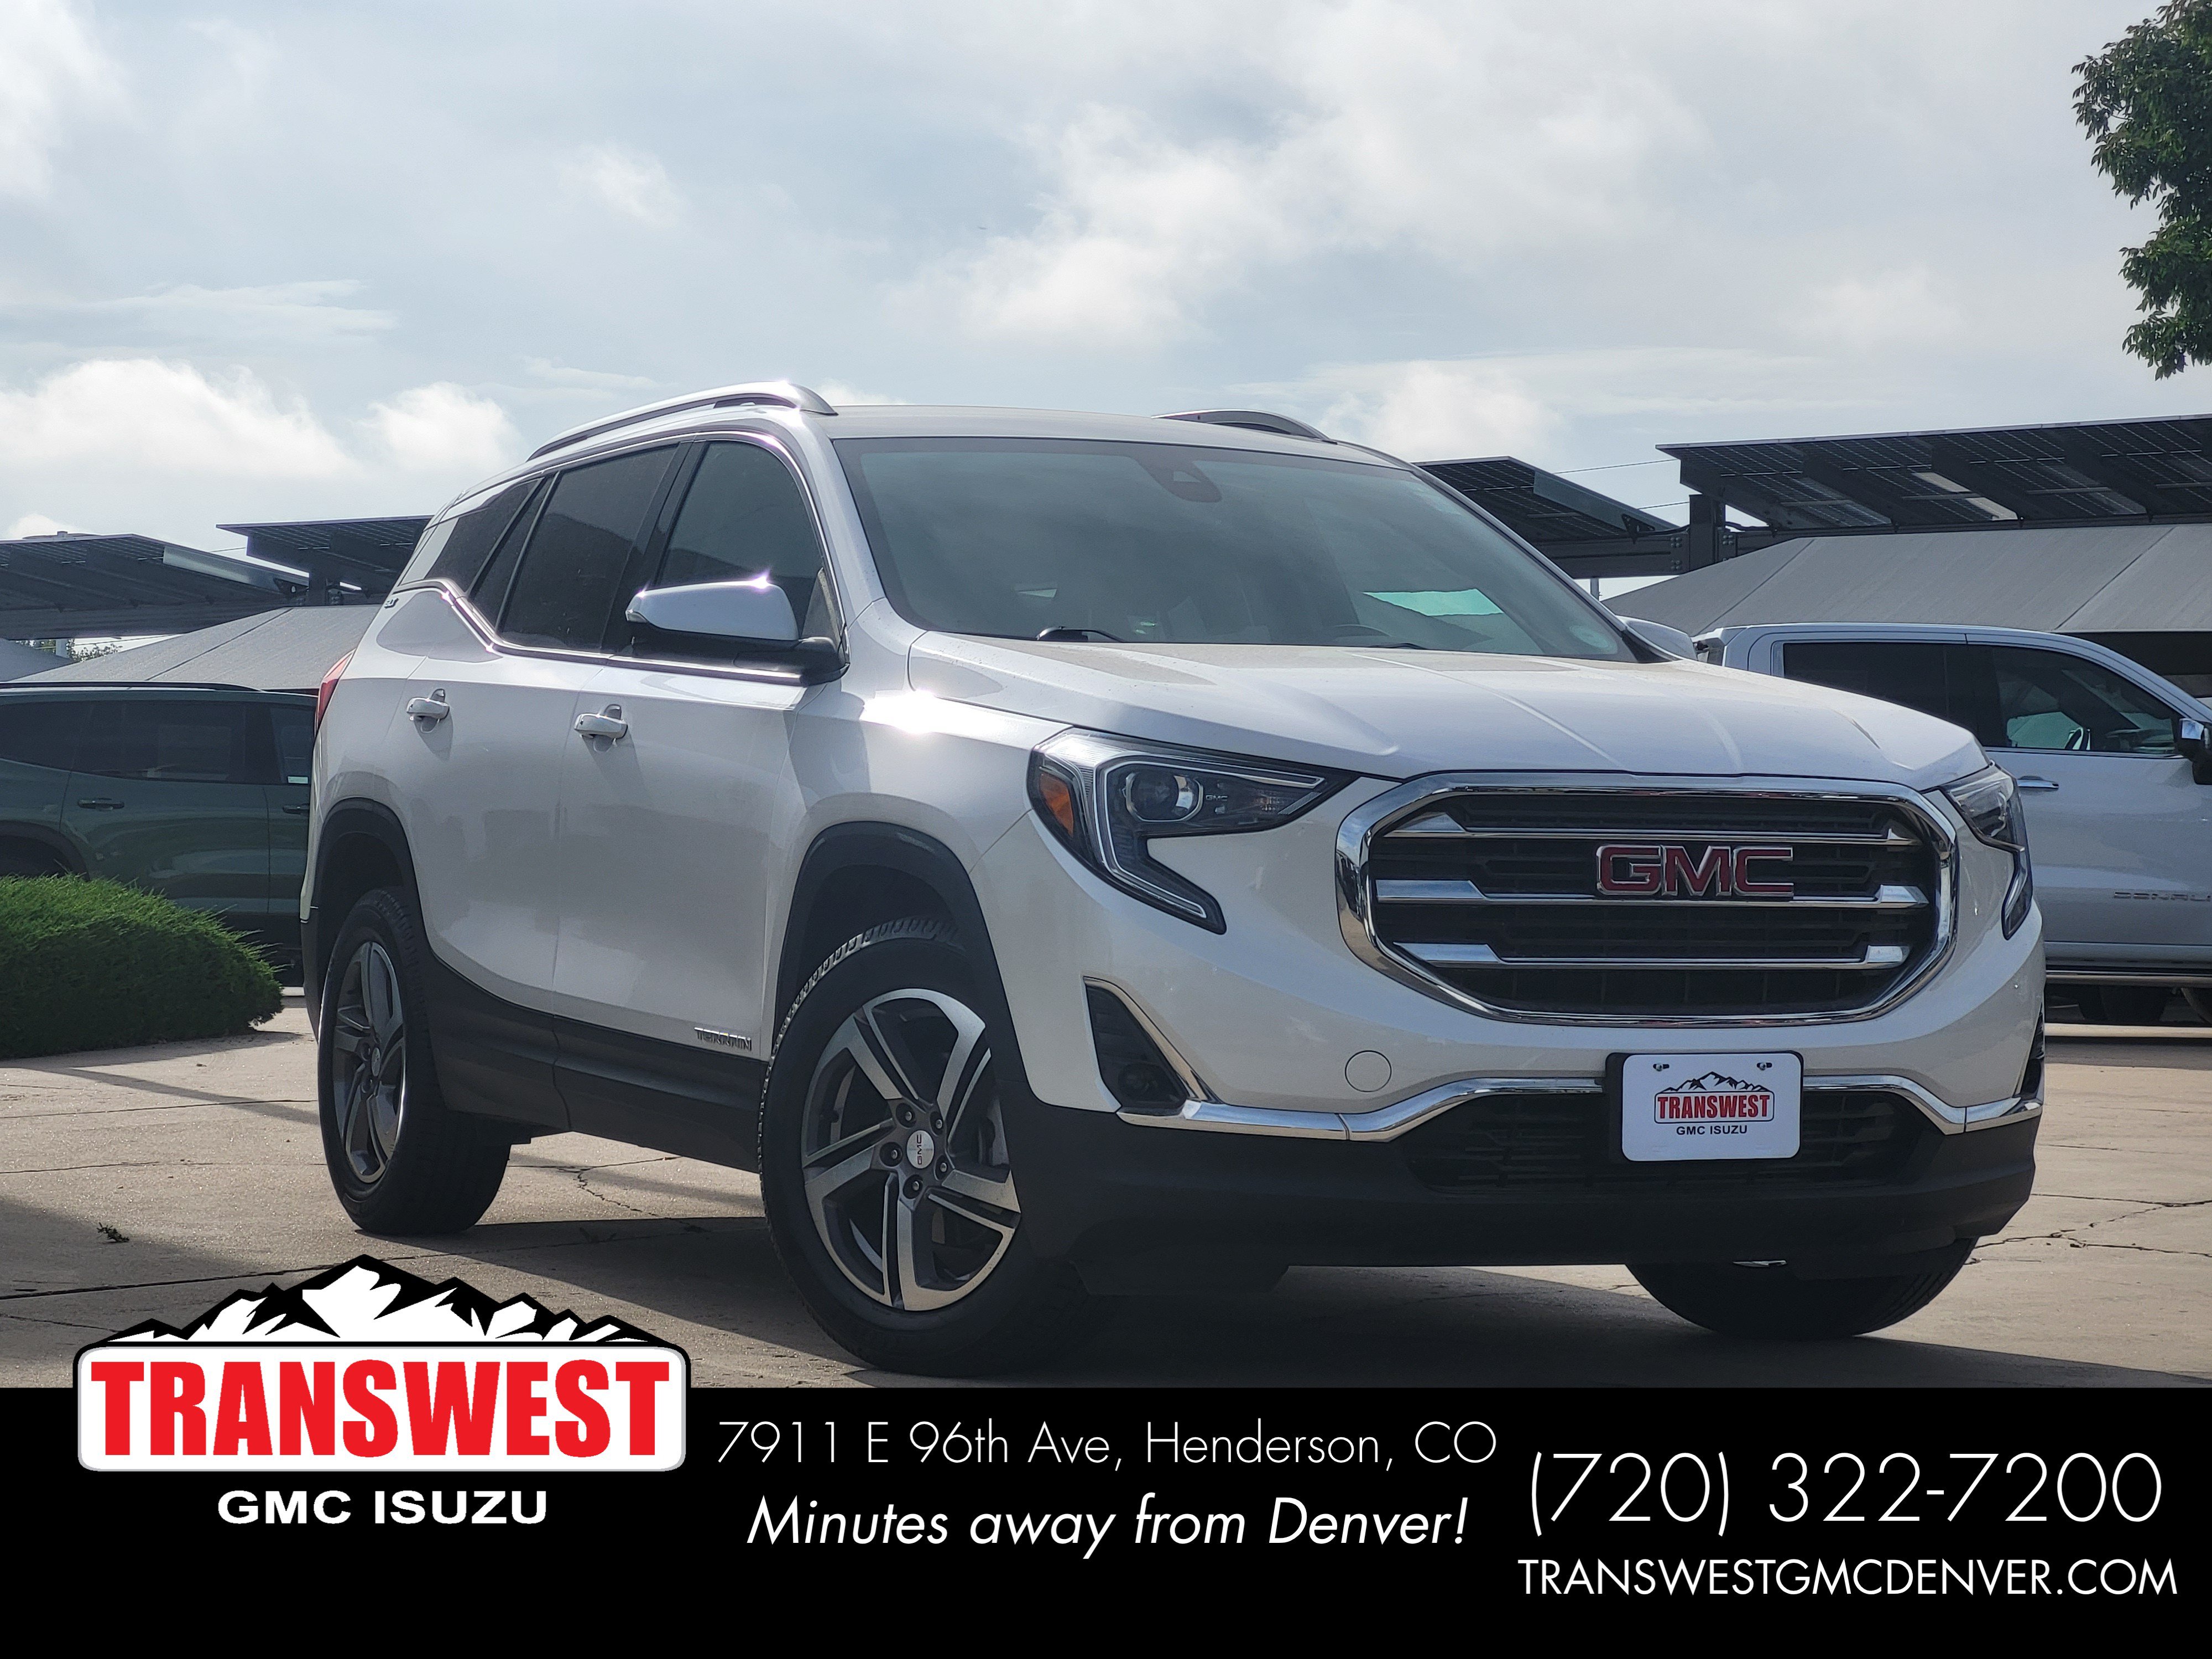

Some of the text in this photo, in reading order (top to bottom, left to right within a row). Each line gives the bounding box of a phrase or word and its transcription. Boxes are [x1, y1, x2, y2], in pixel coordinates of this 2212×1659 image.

[1596, 844, 1794, 896] GMC
[1657, 1094, 1770, 1119] TRANSWEST
[1676, 1124, 1747, 1135] GMC ISUZU
